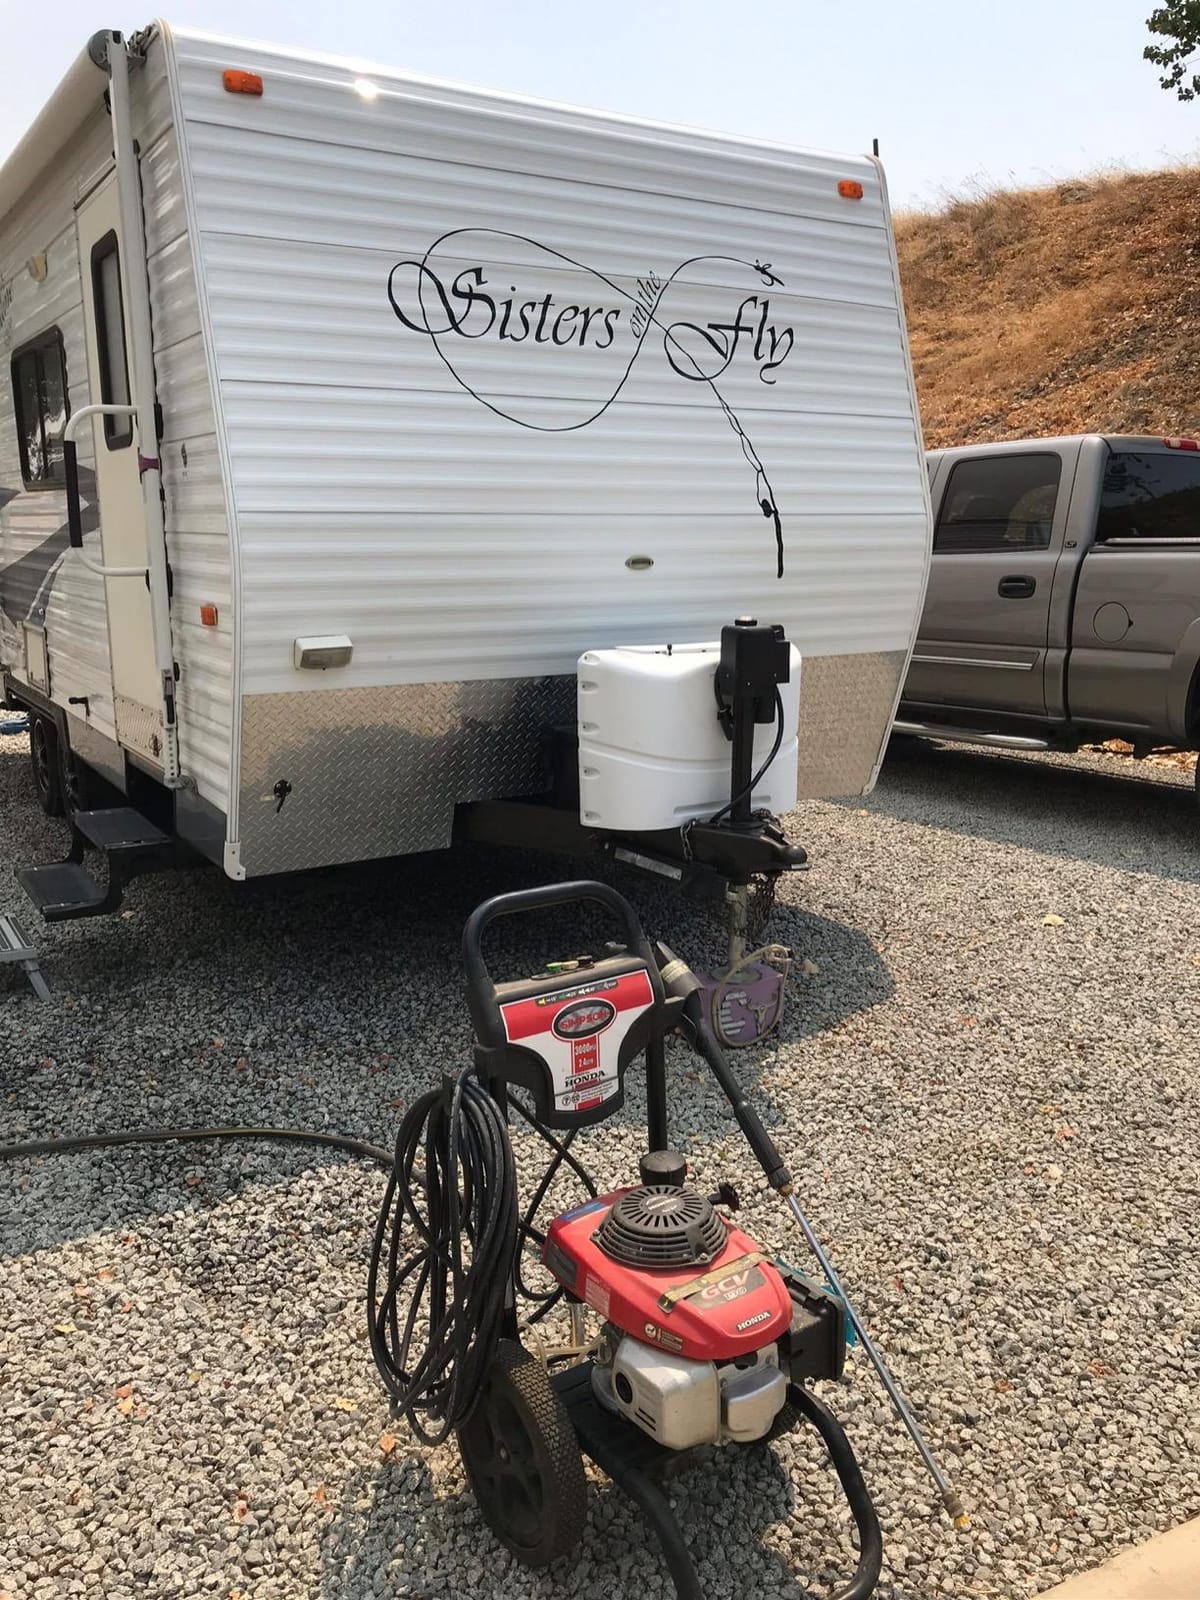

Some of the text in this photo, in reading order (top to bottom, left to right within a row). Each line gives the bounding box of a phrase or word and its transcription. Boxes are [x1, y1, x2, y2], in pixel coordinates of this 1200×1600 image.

[387, 260, 621, 349] Sisters
[629, 269, 661, 339] on the
[559, 1008, 610, 1031] SIMPSON
[564, 1070, 606, 1088] HONDA
[700, 1269, 751, 1301] GCV
[736, 1311, 771, 1331] HONDA
